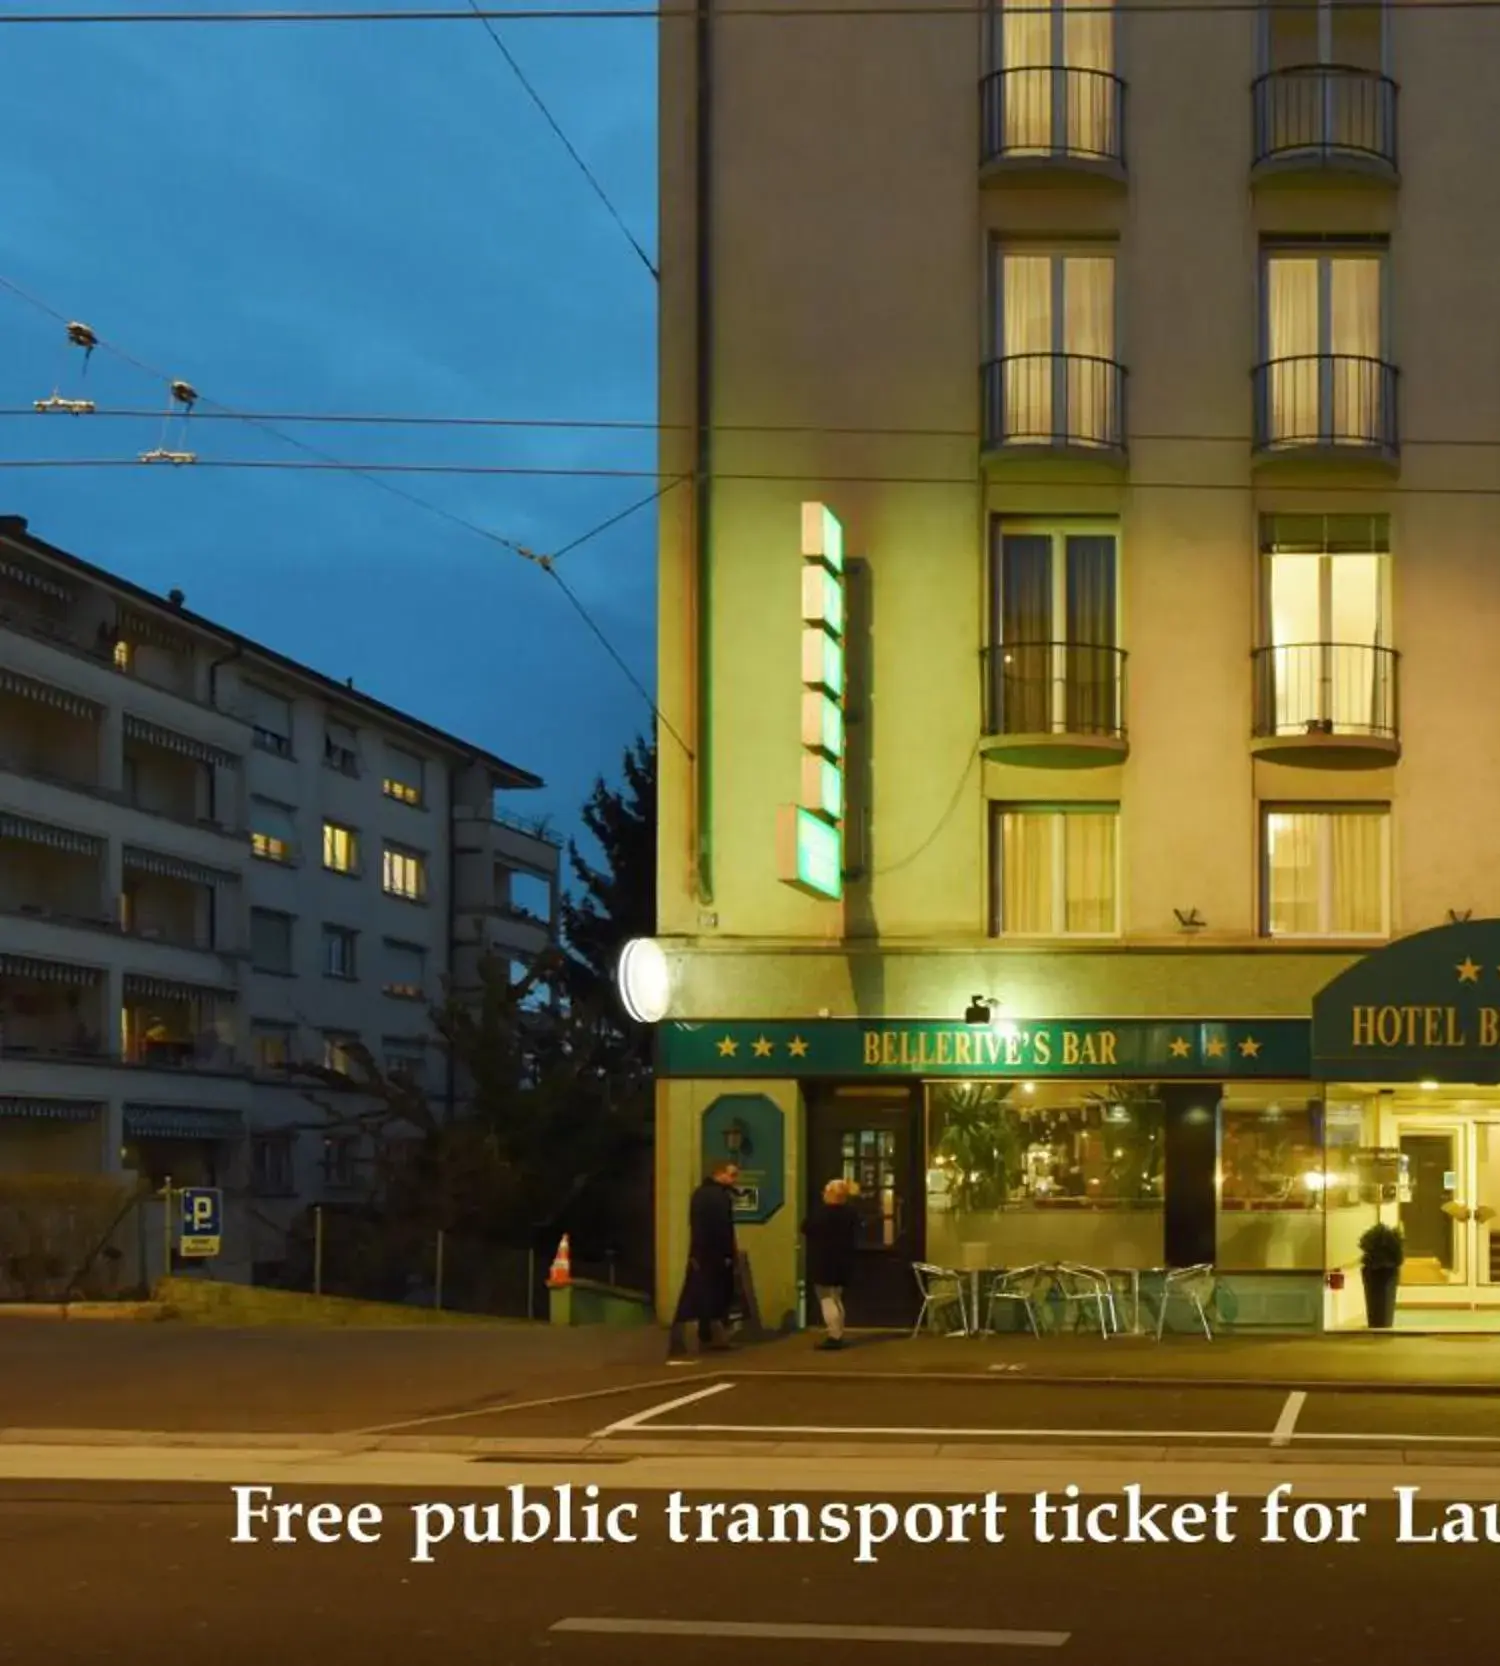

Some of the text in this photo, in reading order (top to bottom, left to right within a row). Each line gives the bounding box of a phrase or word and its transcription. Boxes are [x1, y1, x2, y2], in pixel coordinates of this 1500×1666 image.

[1352, 1005, 1466, 1047] HOTEL
[863, 1030, 1118, 1065] BELLERIVE'S BAR
[193, 1196, 212, 1231] P
